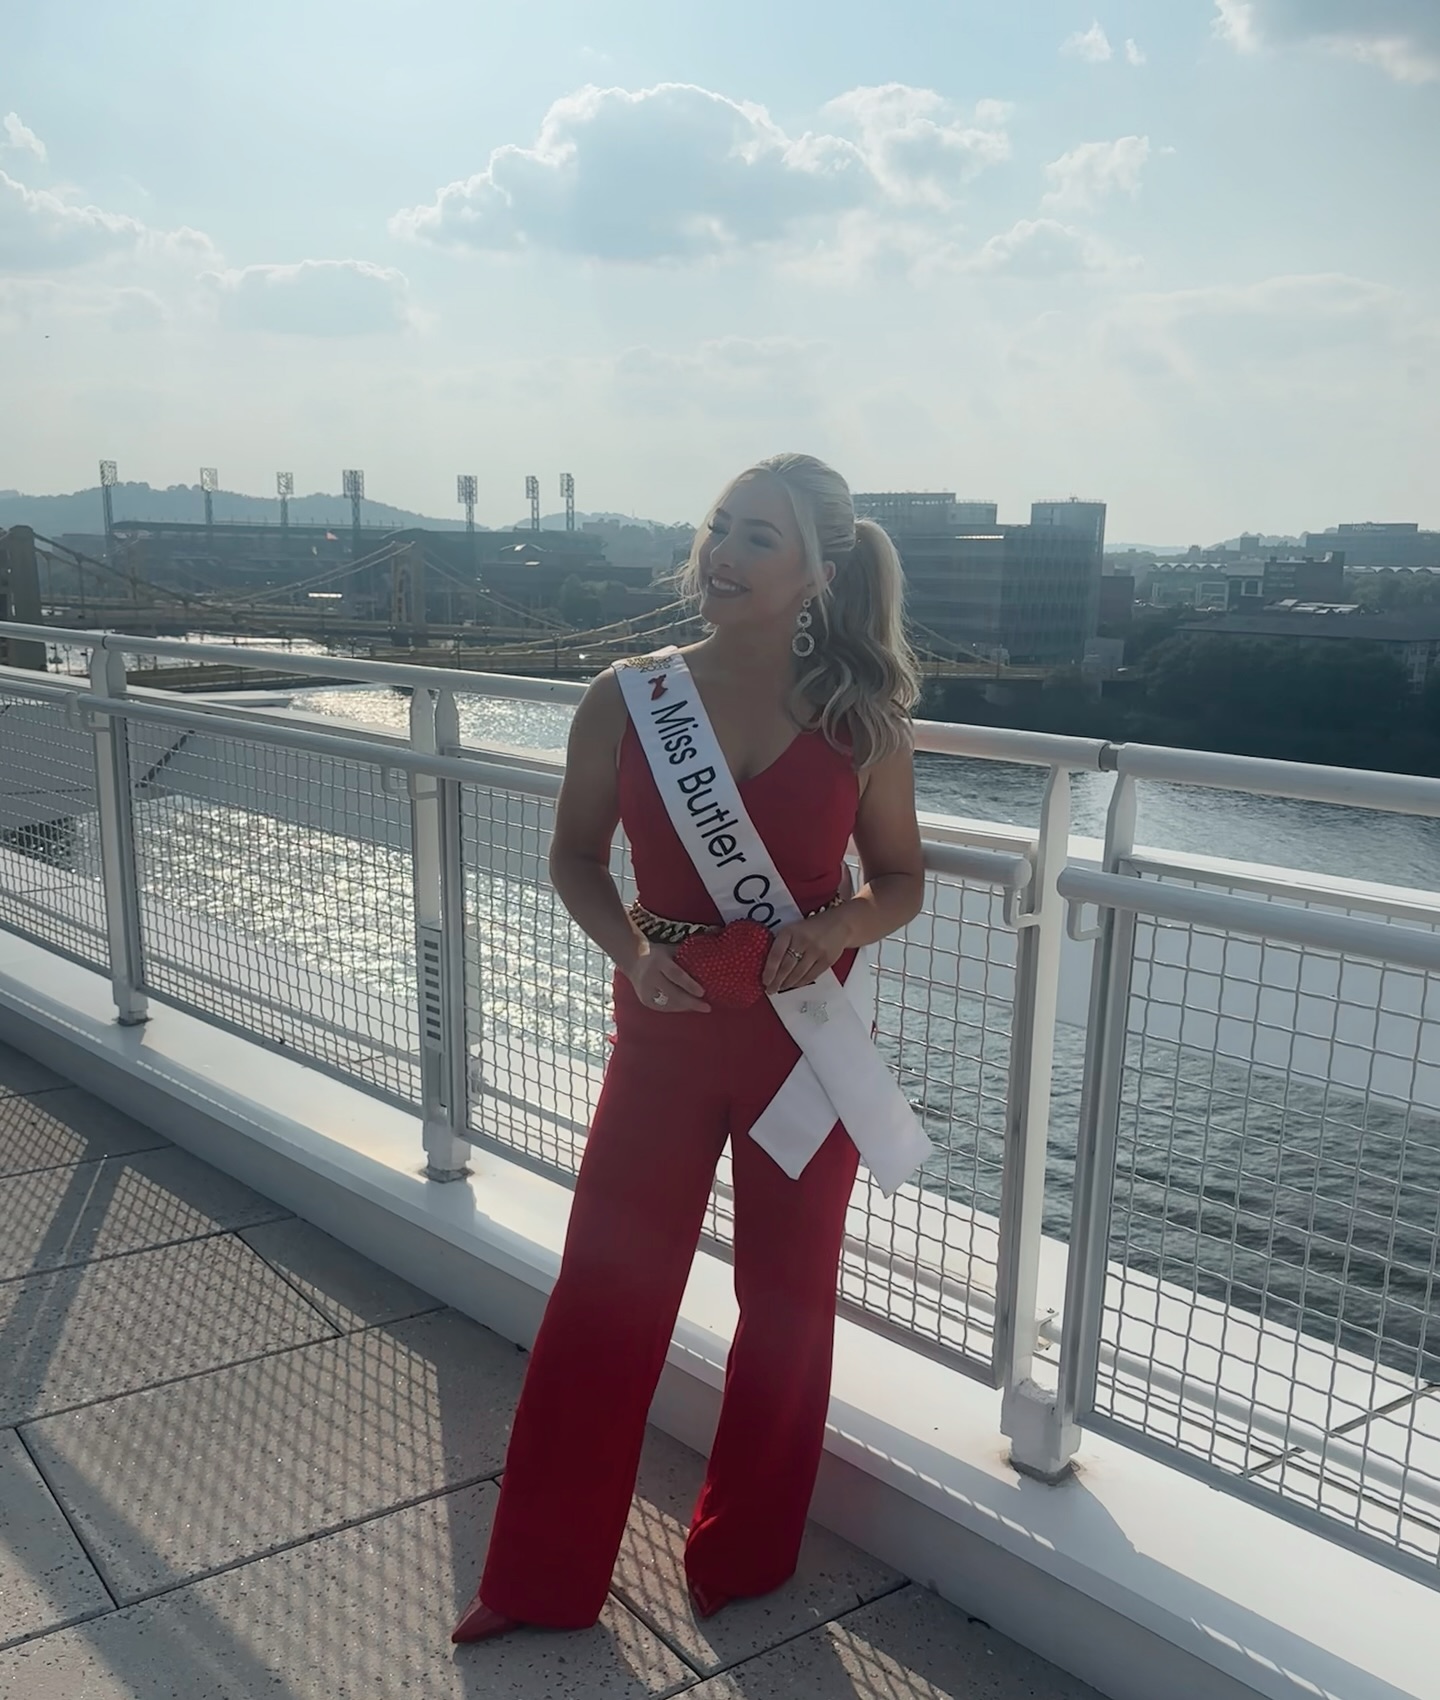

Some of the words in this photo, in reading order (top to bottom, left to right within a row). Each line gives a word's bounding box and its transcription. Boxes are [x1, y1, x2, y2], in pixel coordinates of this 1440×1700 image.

[651, 700, 699, 765] Miss
[677, 766, 747, 868] Butler
[733, 874, 781, 928] Co
